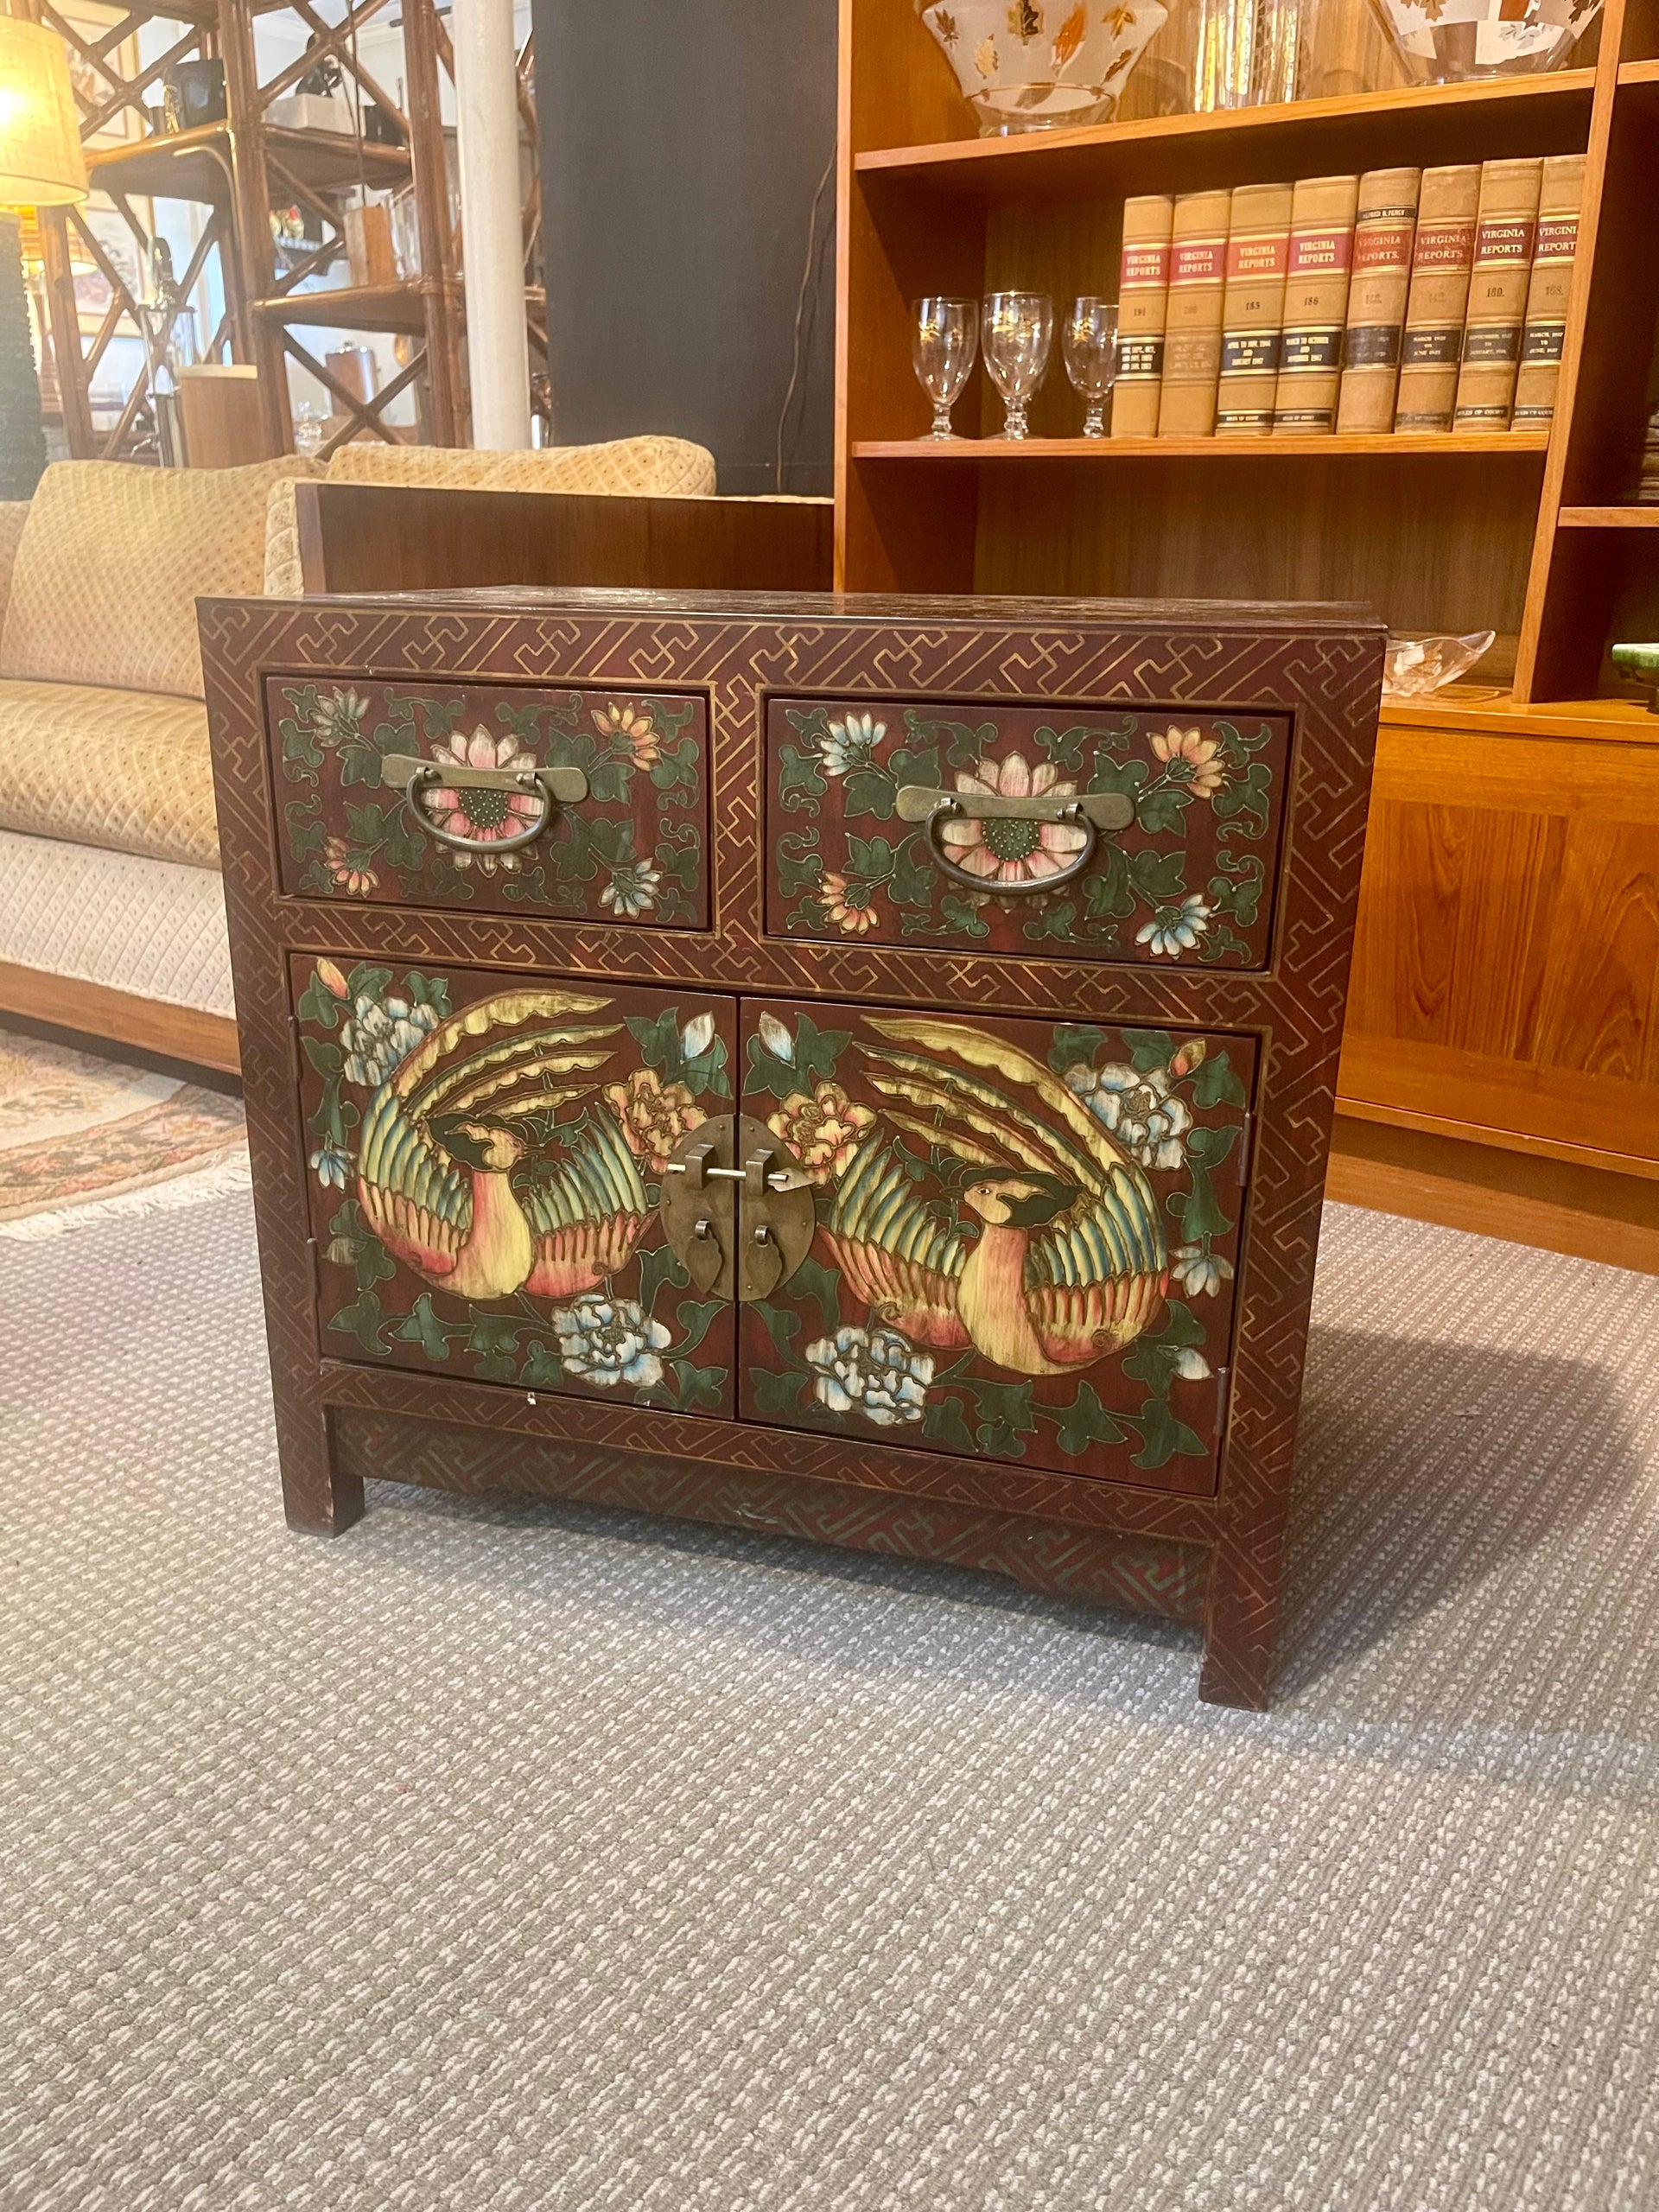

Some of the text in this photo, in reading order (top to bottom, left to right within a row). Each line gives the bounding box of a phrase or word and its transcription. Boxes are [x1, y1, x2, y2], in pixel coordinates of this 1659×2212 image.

[1482, 228, 1525, 238] VIRGINIA
[1539, 226, 1576, 236] VIRGINI
[1359, 236, 1401, 247] VIRGINIA
[1421, 234, 1466, 245] VIRGINIA
[1300, 240, 1335, 251] VIRGINIA
[1481, 245, 1522, 254] REPORTS
[1538, 242, 1577, 251] REPORT
[1179, 251, 1213, 261] VIRGINIA
[1239, 245, 1275, 257] VIRGINIA
[1358, 251, 1400, 261] EPORTS.
[1418, 251, 1464, 261] REPORTS
[1127, 255, 1160, 264] VIRGINIA
[1238, 257, 1275, 269] REPORTS
[1299, 253, 1334, 264] REPORTS
[1126, 266, 1160, 276] REPORTS
[1179, 262, 1212, 273] REPORTS
